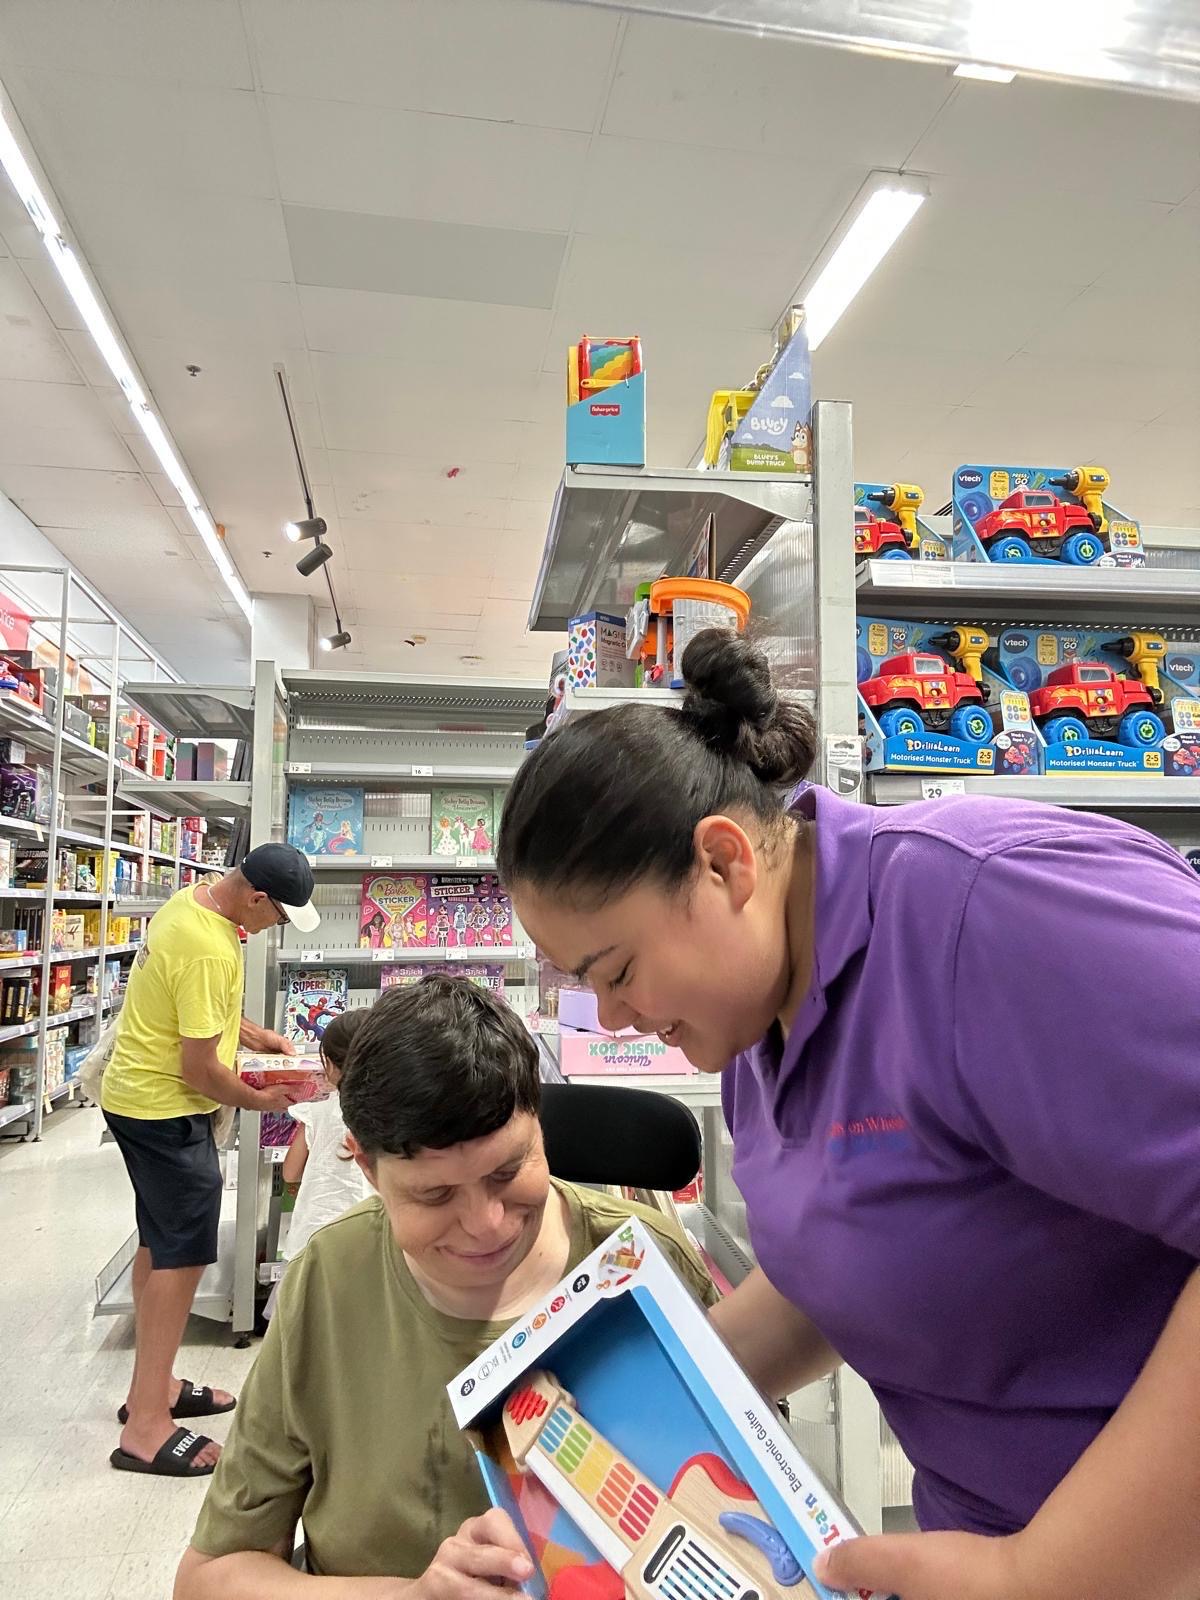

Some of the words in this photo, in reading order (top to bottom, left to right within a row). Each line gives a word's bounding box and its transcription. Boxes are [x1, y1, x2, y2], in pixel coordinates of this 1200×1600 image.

[958, 474, 982, 482] vtech
[893, 632, 906, 641] GO
[1004, 638, 1029, 647] vtech
[1063, 642, 1078, 650] GO
[1169, 663, 1194, 672] vtech
[890, 753, 925, 762] Motorised
[925, 755, 952, 764] Monster
[979, 751, 992, 759] 2-5
[1145, 754, 1159, 762] 2-5
[1049, 759, 1086, 767] Motorised
[1087, 760, 1116, 768] Monster
[434, 885, 471, 896] STICKER
[378, 896, 416, 905] STICKER
[291, 979, 343, 995] SUPERSTAR
[588, 1041, 620, 1057] BOX
[623, 1041, 667, 1057] MUSIC
[602, 1054, 652, 1067] Unicorn
[744, 1410, 769, 1441] Guitar
[765, 1438, 802, 1493] Electronic
[804, 1493, 840, 1546] Learn
